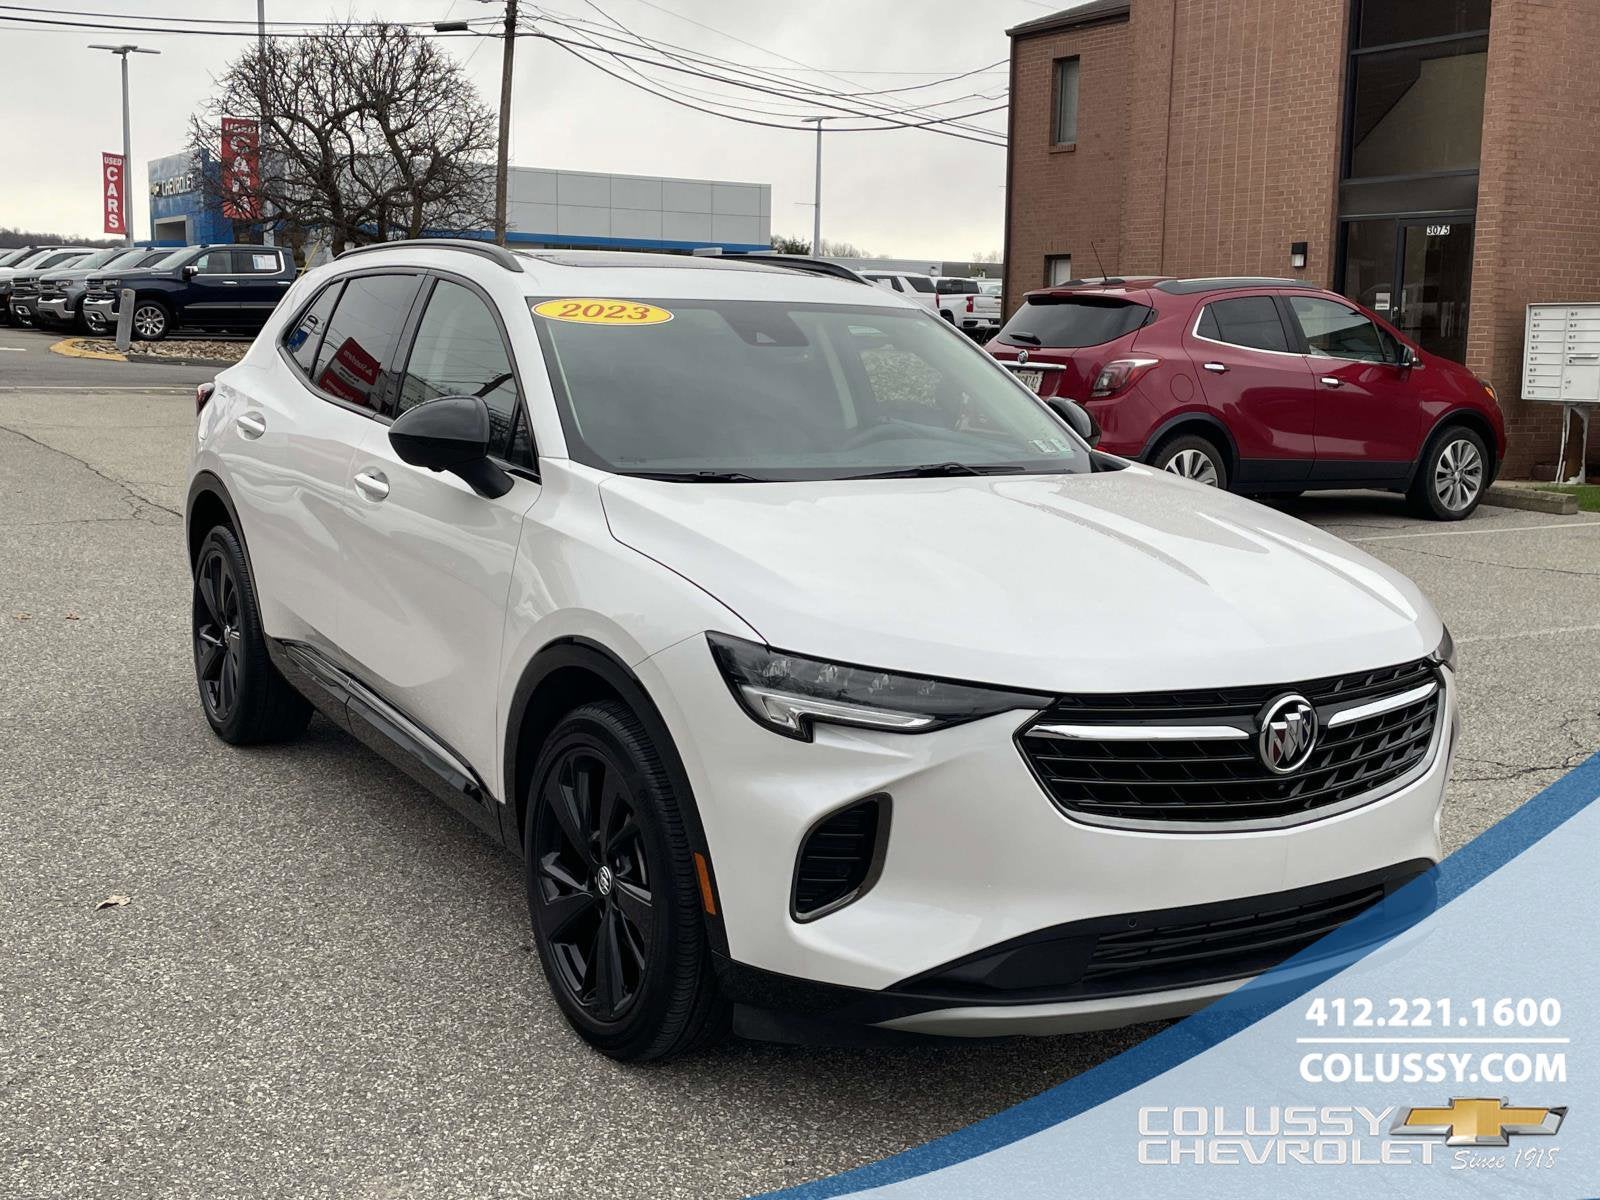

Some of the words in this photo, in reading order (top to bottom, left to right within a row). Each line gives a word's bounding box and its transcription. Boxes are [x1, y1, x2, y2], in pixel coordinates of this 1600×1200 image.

[104, 156, 122, 166] USED
[106, 166, 120, 229] CARS
[1427, 225, 1450, 236] 3075
[558, 303, 650, 320] 2023
